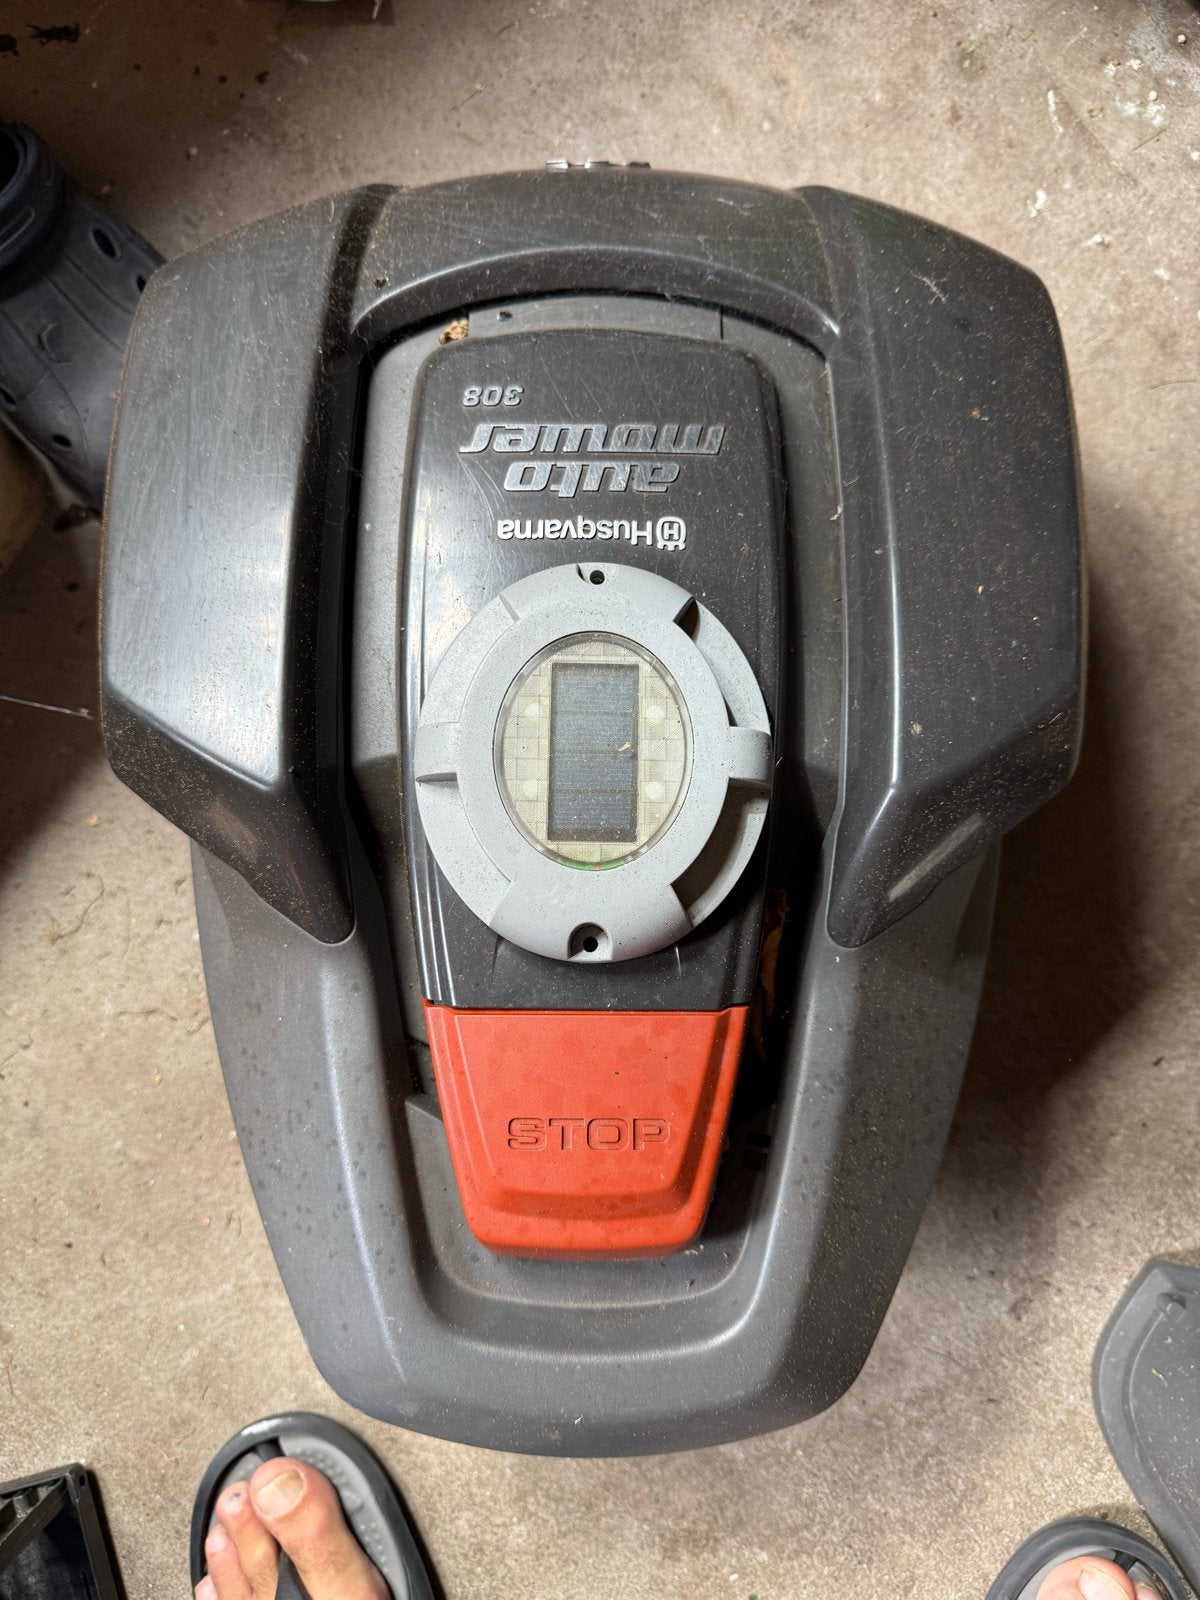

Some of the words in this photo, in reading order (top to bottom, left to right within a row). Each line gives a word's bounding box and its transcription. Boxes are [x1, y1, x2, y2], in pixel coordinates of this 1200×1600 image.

[463, 385, 523, 407] 308
[459, 423, 725, 455] mower
[504, 461, 680, 498] auto
[497, 515, 653, 546] Husqvarna
[508, 1117, 670, 1151] STOP
